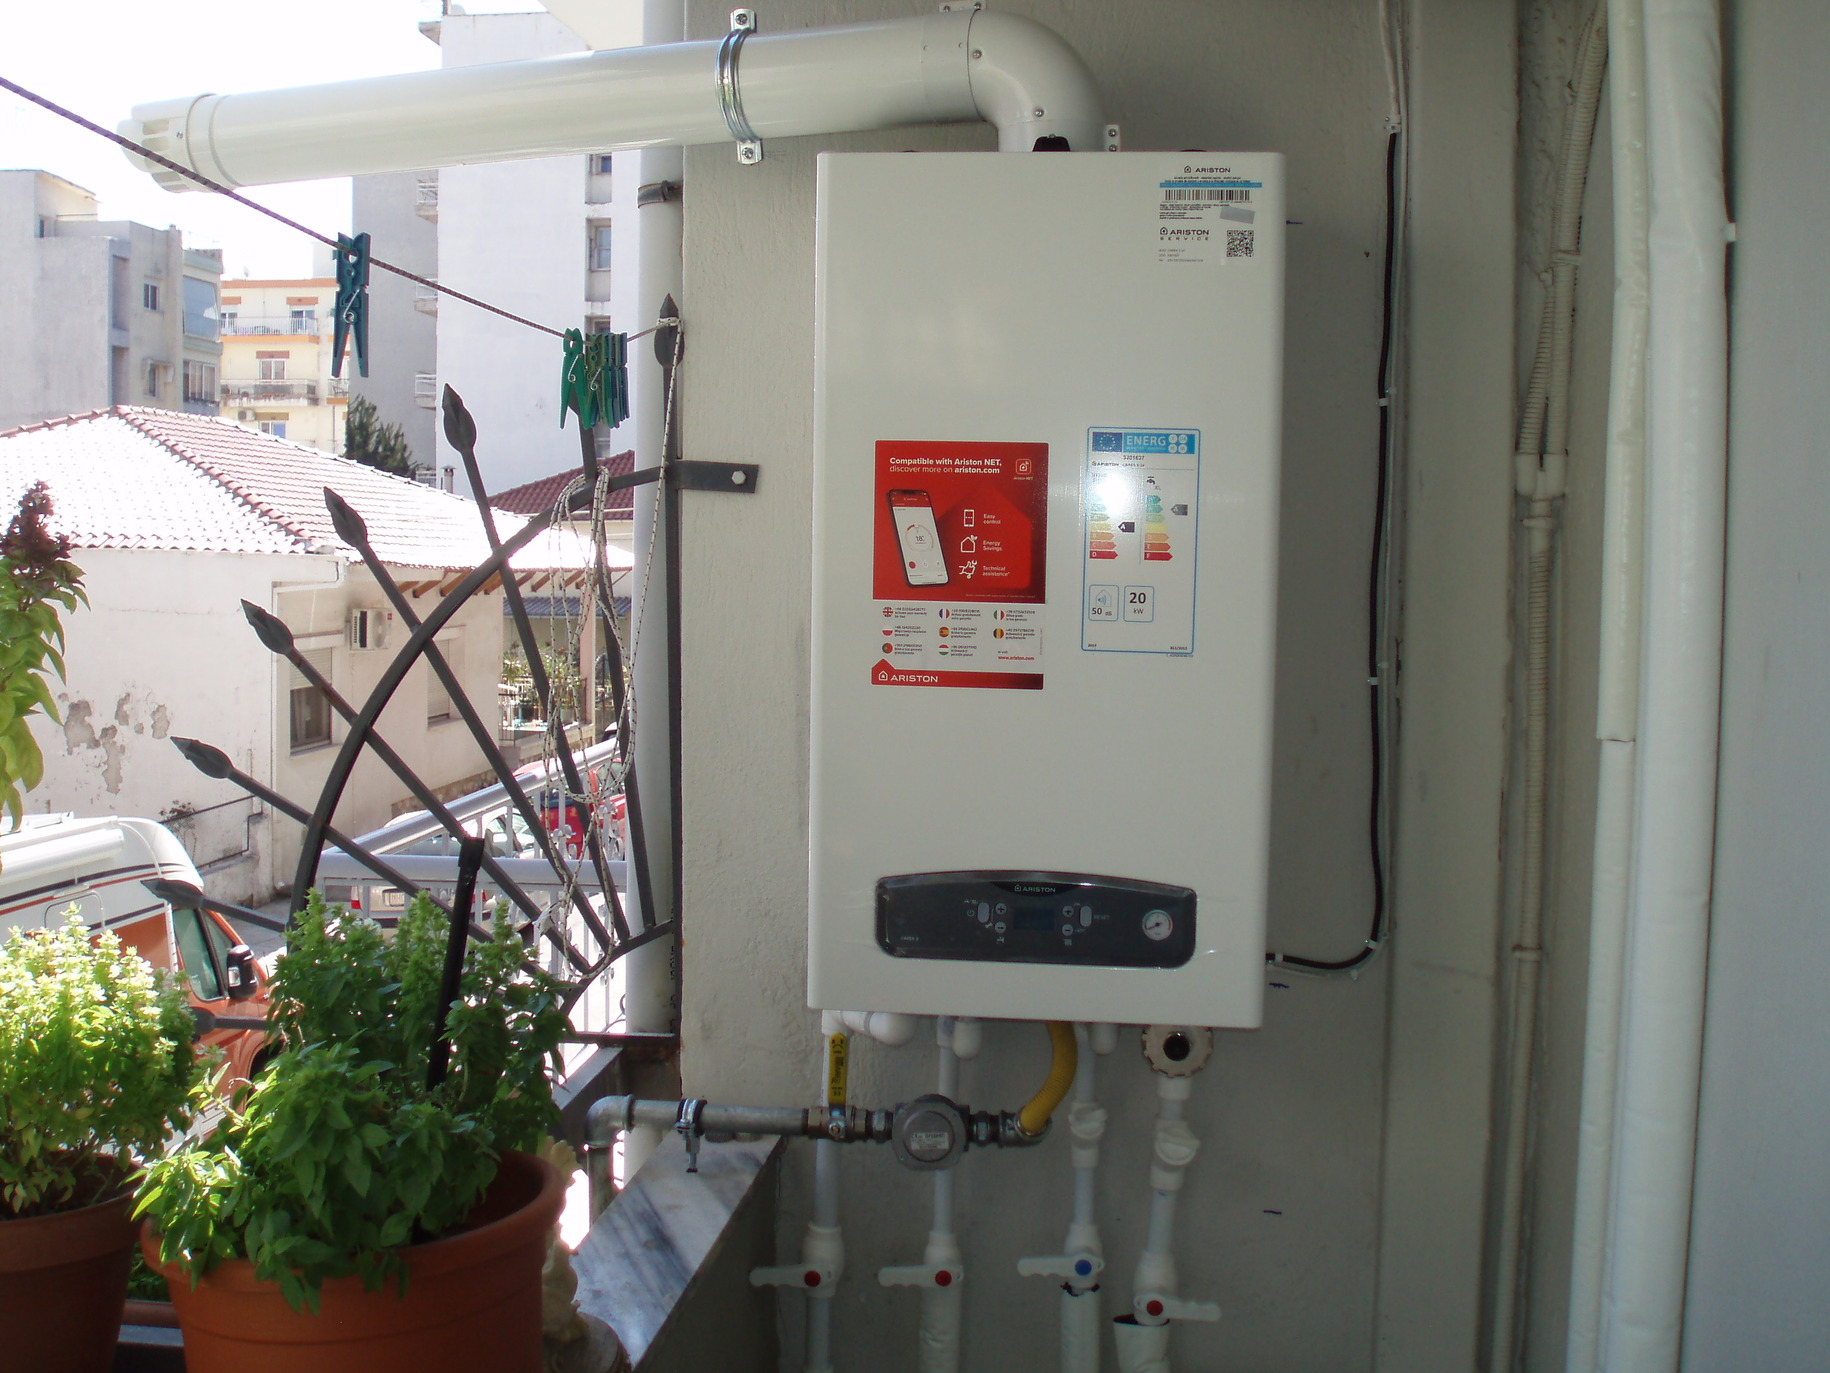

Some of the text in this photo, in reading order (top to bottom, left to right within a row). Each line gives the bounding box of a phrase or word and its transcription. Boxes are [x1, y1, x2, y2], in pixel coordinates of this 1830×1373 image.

[1126, 435, 1166, 446] ENERG
[889, 457, 934, 467] Compatible
[935, 457, 953, 465] with
[954, 458, 983, 466] Ariston
[889, 465, 922, 473] discover
[954, 466, 1000, 474] ariston.com
[1129, 592, 1147, 604] 20
[1091, 607, 1103, 615] 50
[890, 674, 939, 683] ARISTON
